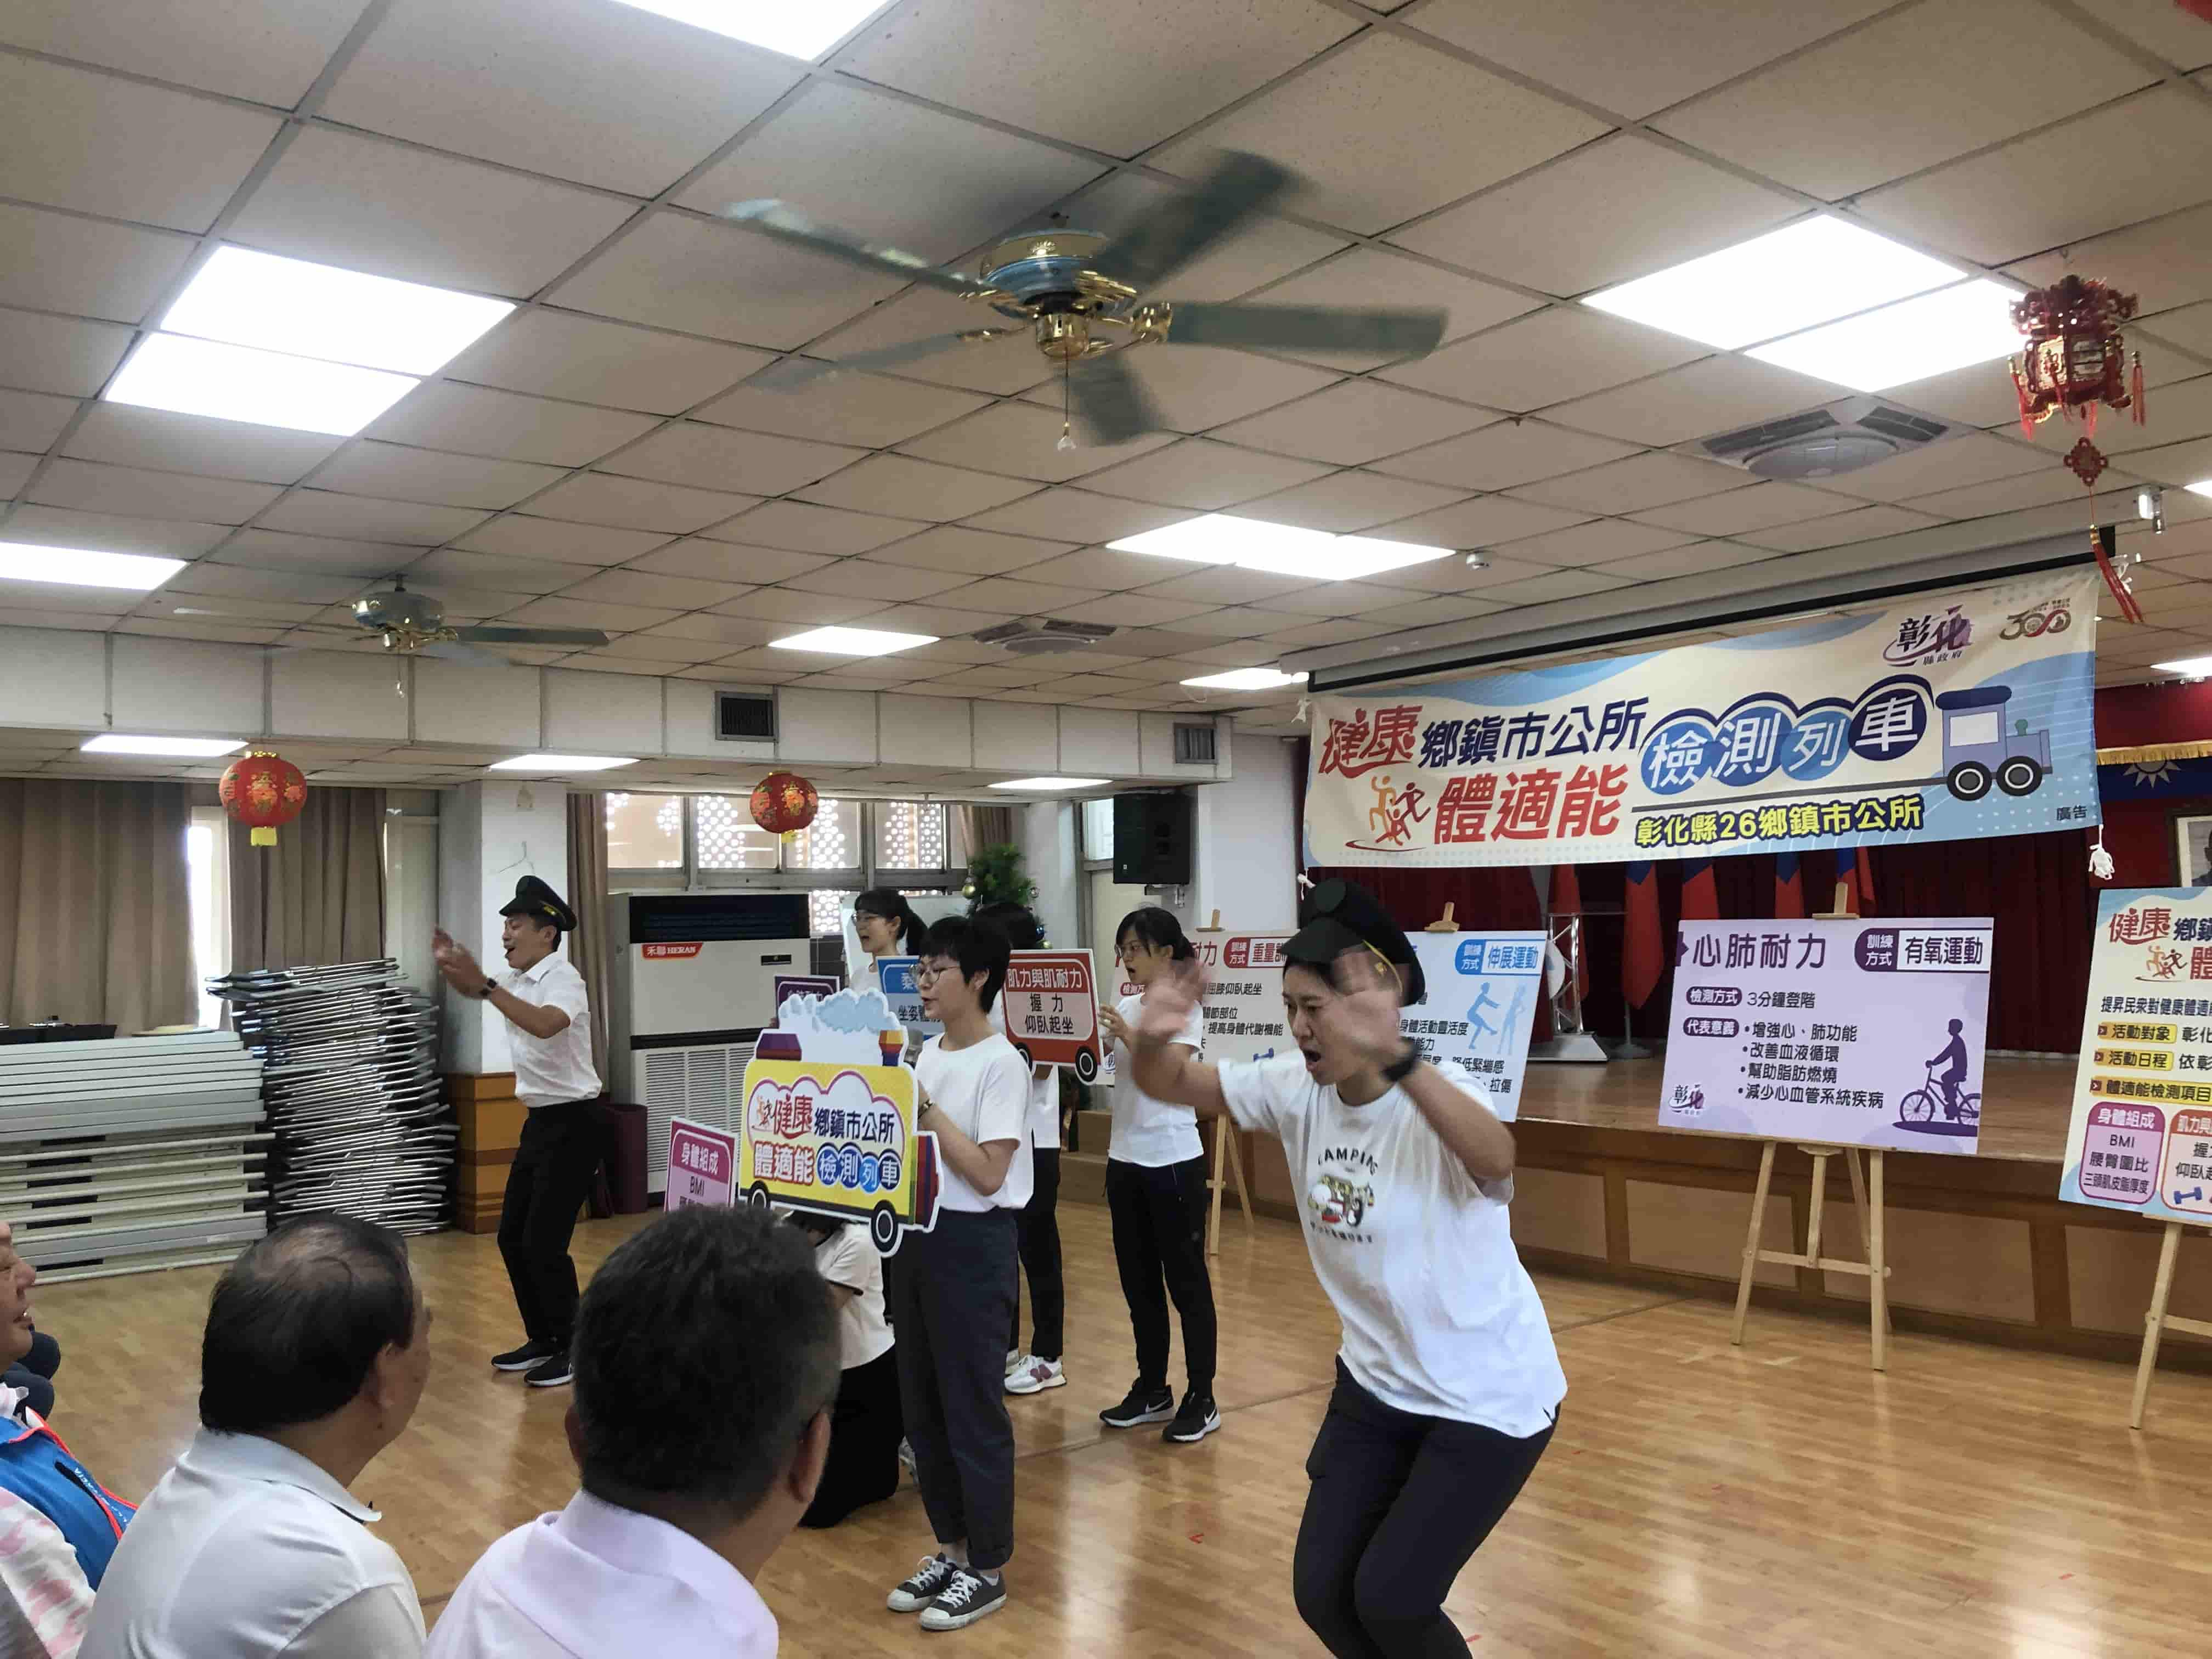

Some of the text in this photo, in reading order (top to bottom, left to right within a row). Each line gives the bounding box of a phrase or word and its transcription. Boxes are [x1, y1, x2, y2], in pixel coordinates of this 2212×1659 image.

[1318, 697, 1649, 778] 健康 鄉鎮市公所
[1650, 693, 1918, 789] 檢測列車
[1434, 764, 1628, 845] 體適能
[2056, 805, 2087, 822] 廣告
[1636, 796, 1922, 847] 彰化縣26鄉鎮市公所
[2109, 907, 2171, 945] 健康
[1488, 945, 1538, 969] 伸展運動
[1692, 933, 1894, 970] 心肺耐力 訓練
[1865, 951, 1892, 966] 方式
[1905, 936, 1983, 965] 有氧運動
[1007, 967, 1082, 988] 肌力與肌耐力
[1690, 989, 1816, 1009] 檢測方式 3分鐘登階
[2101, 996, 2212, 1017] 提昇民眾對健康體適
[1024, 1015, 1075, 1034] 仰臥起坐
[1686, 1019, 1735, 1035] 代表意義
[2112, 1024, 2170, 1041] 活動對象
[1750, 1042, 1839, 1063] 改善血液循環
[2109, 1051, 2168, 1068] 活動日程
[1747, 1062, 1838, 1084] 幫助脂肪燃燒
[1744, 1083, 1884, 1109] 減少心血管系統疾病
[2106, 1079, 2211, 1102] 體適能檢測項目
[773, 1094, 895, 1145] 健康 鄉鎮市公所
[2098, 1108, 2155, 1129] 身體組成
[2109, 1134, 2135, 1148] BMI
[754, 1142, 901, 1190] 體適能 檢測列車
[689, 1176, 705, 1197] BMI
